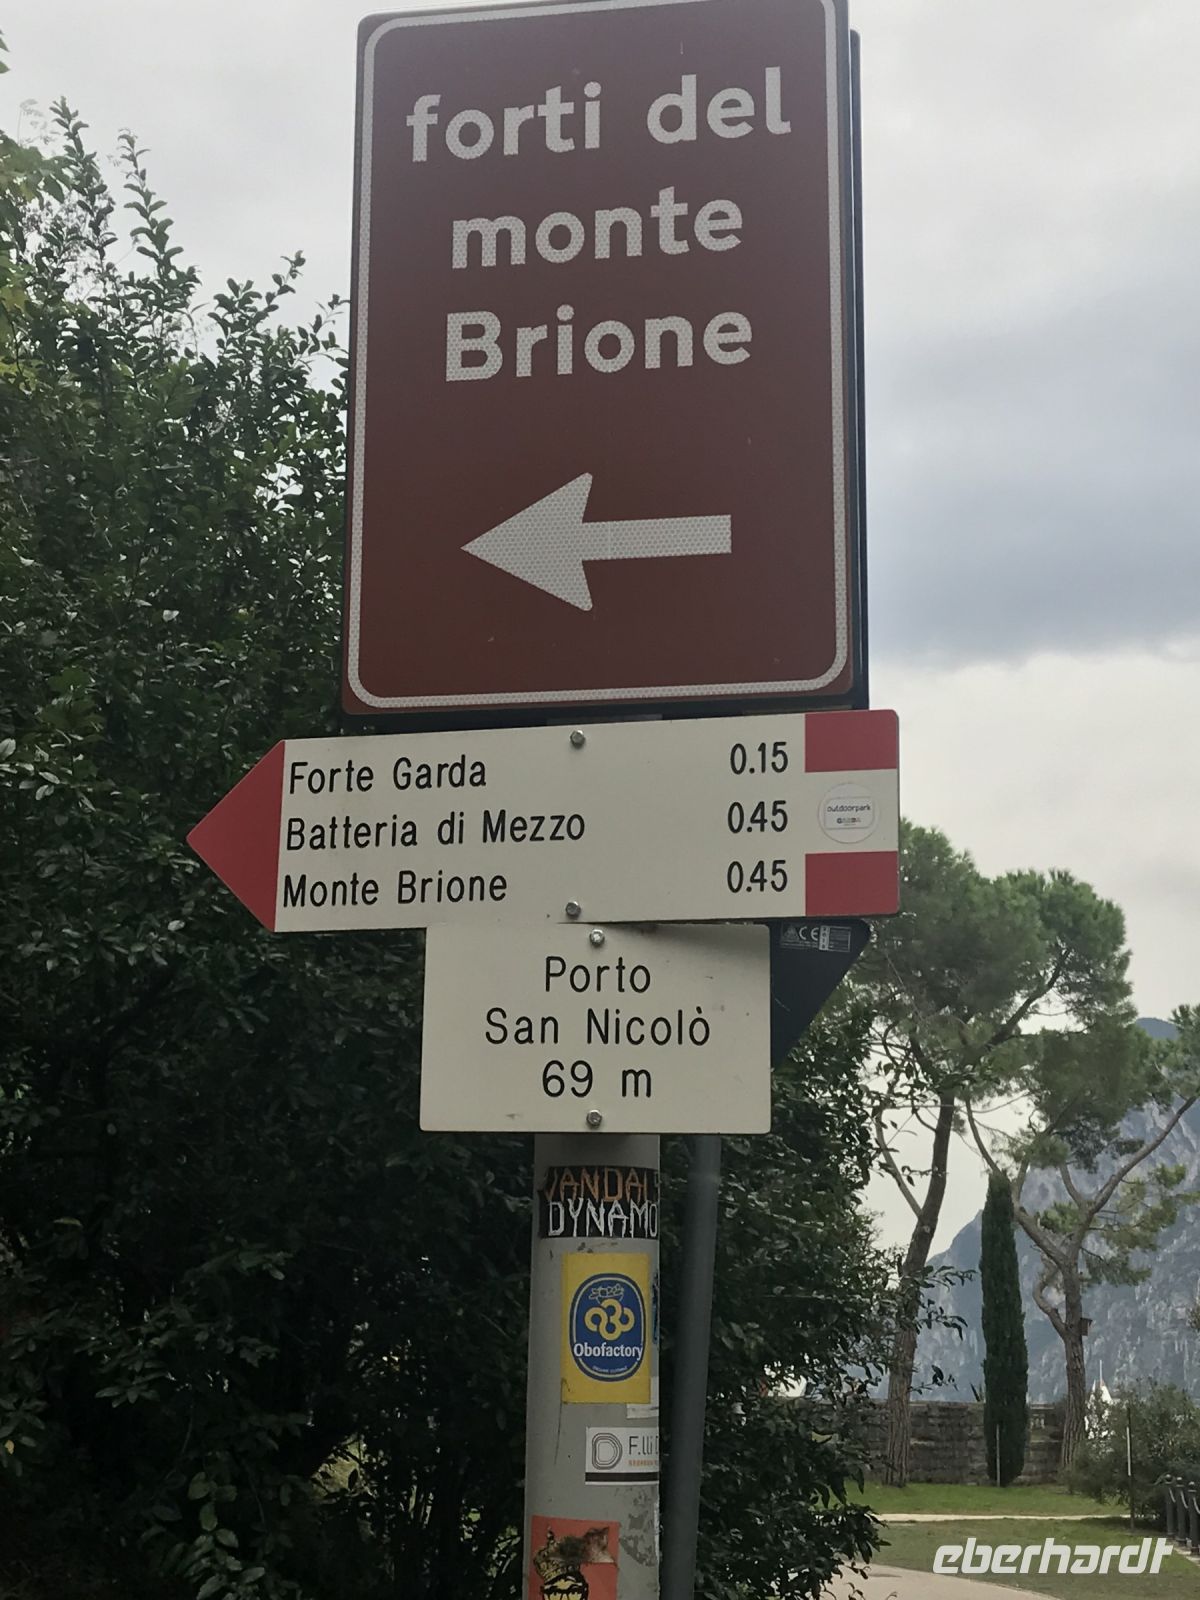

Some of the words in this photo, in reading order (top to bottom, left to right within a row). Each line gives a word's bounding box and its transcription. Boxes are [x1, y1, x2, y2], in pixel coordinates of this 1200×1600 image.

[406, 81, 602, 162] forti
[647, 66, 792, 144] del
[452, 186, 743, 269] monte
[445, 304, 753, 382] Brione
[289, 759, 374, 795] Forte
[393, 754, 487, 790] Garda
[730, 741, 789, 775] 0.15
[286, 814, 418, 851] Batteria
[437, 811, 465, 845] di
[482, 809, 586, 843] Mezzo
[727, 800, 789, 834] 0.45
[283, 872, 379, 908] Monte
[397, 870, 507, 904] Brione
[727, 859, 788, 893] 0.45
[545, 956, 651, 993] Porto
[485, 1007, 559, 1044] San
[586, 1005, 711, 1046] Nicolò
[542, 1060, 593, 1098] 69
[621, 1069, 652, 1098] m
[547, 1197, 659, 1239] DYNAMO
[573, 1341, 643, 1361] Obofactory
